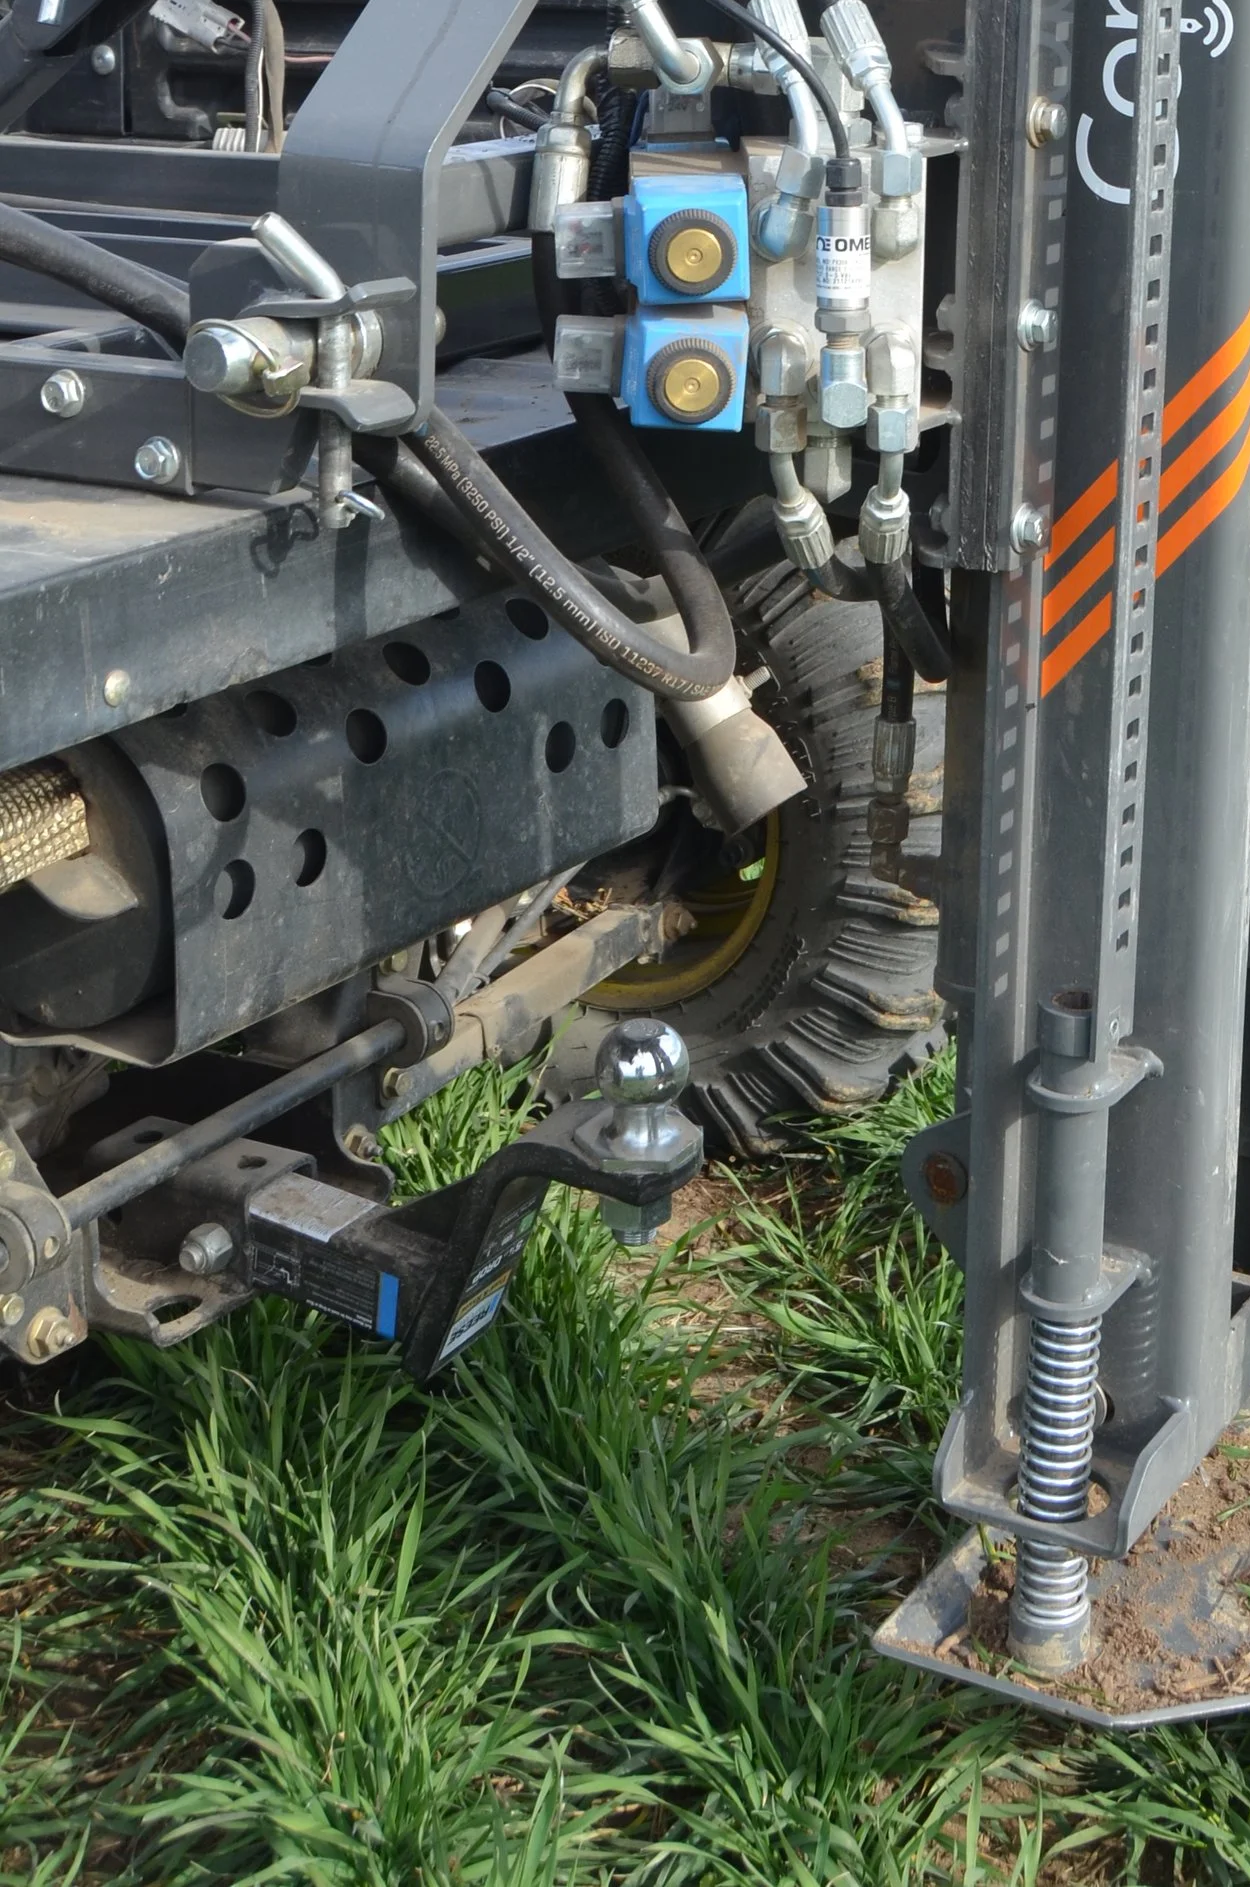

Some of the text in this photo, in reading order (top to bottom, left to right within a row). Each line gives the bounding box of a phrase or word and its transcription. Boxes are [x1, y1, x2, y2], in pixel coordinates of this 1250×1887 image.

[424, 435, 447, 459] 22.5
[441, 455, 461, 481] MPa
[455, 476, 489, 513] (3250
[484, 509, 510, 540] PSI)
[529, 563, 566, 600] (12.5
[563, 598, 597, 633] mm)
[595, 628, 622, 651] ISO
[621, 646, 664, 678] 11237
